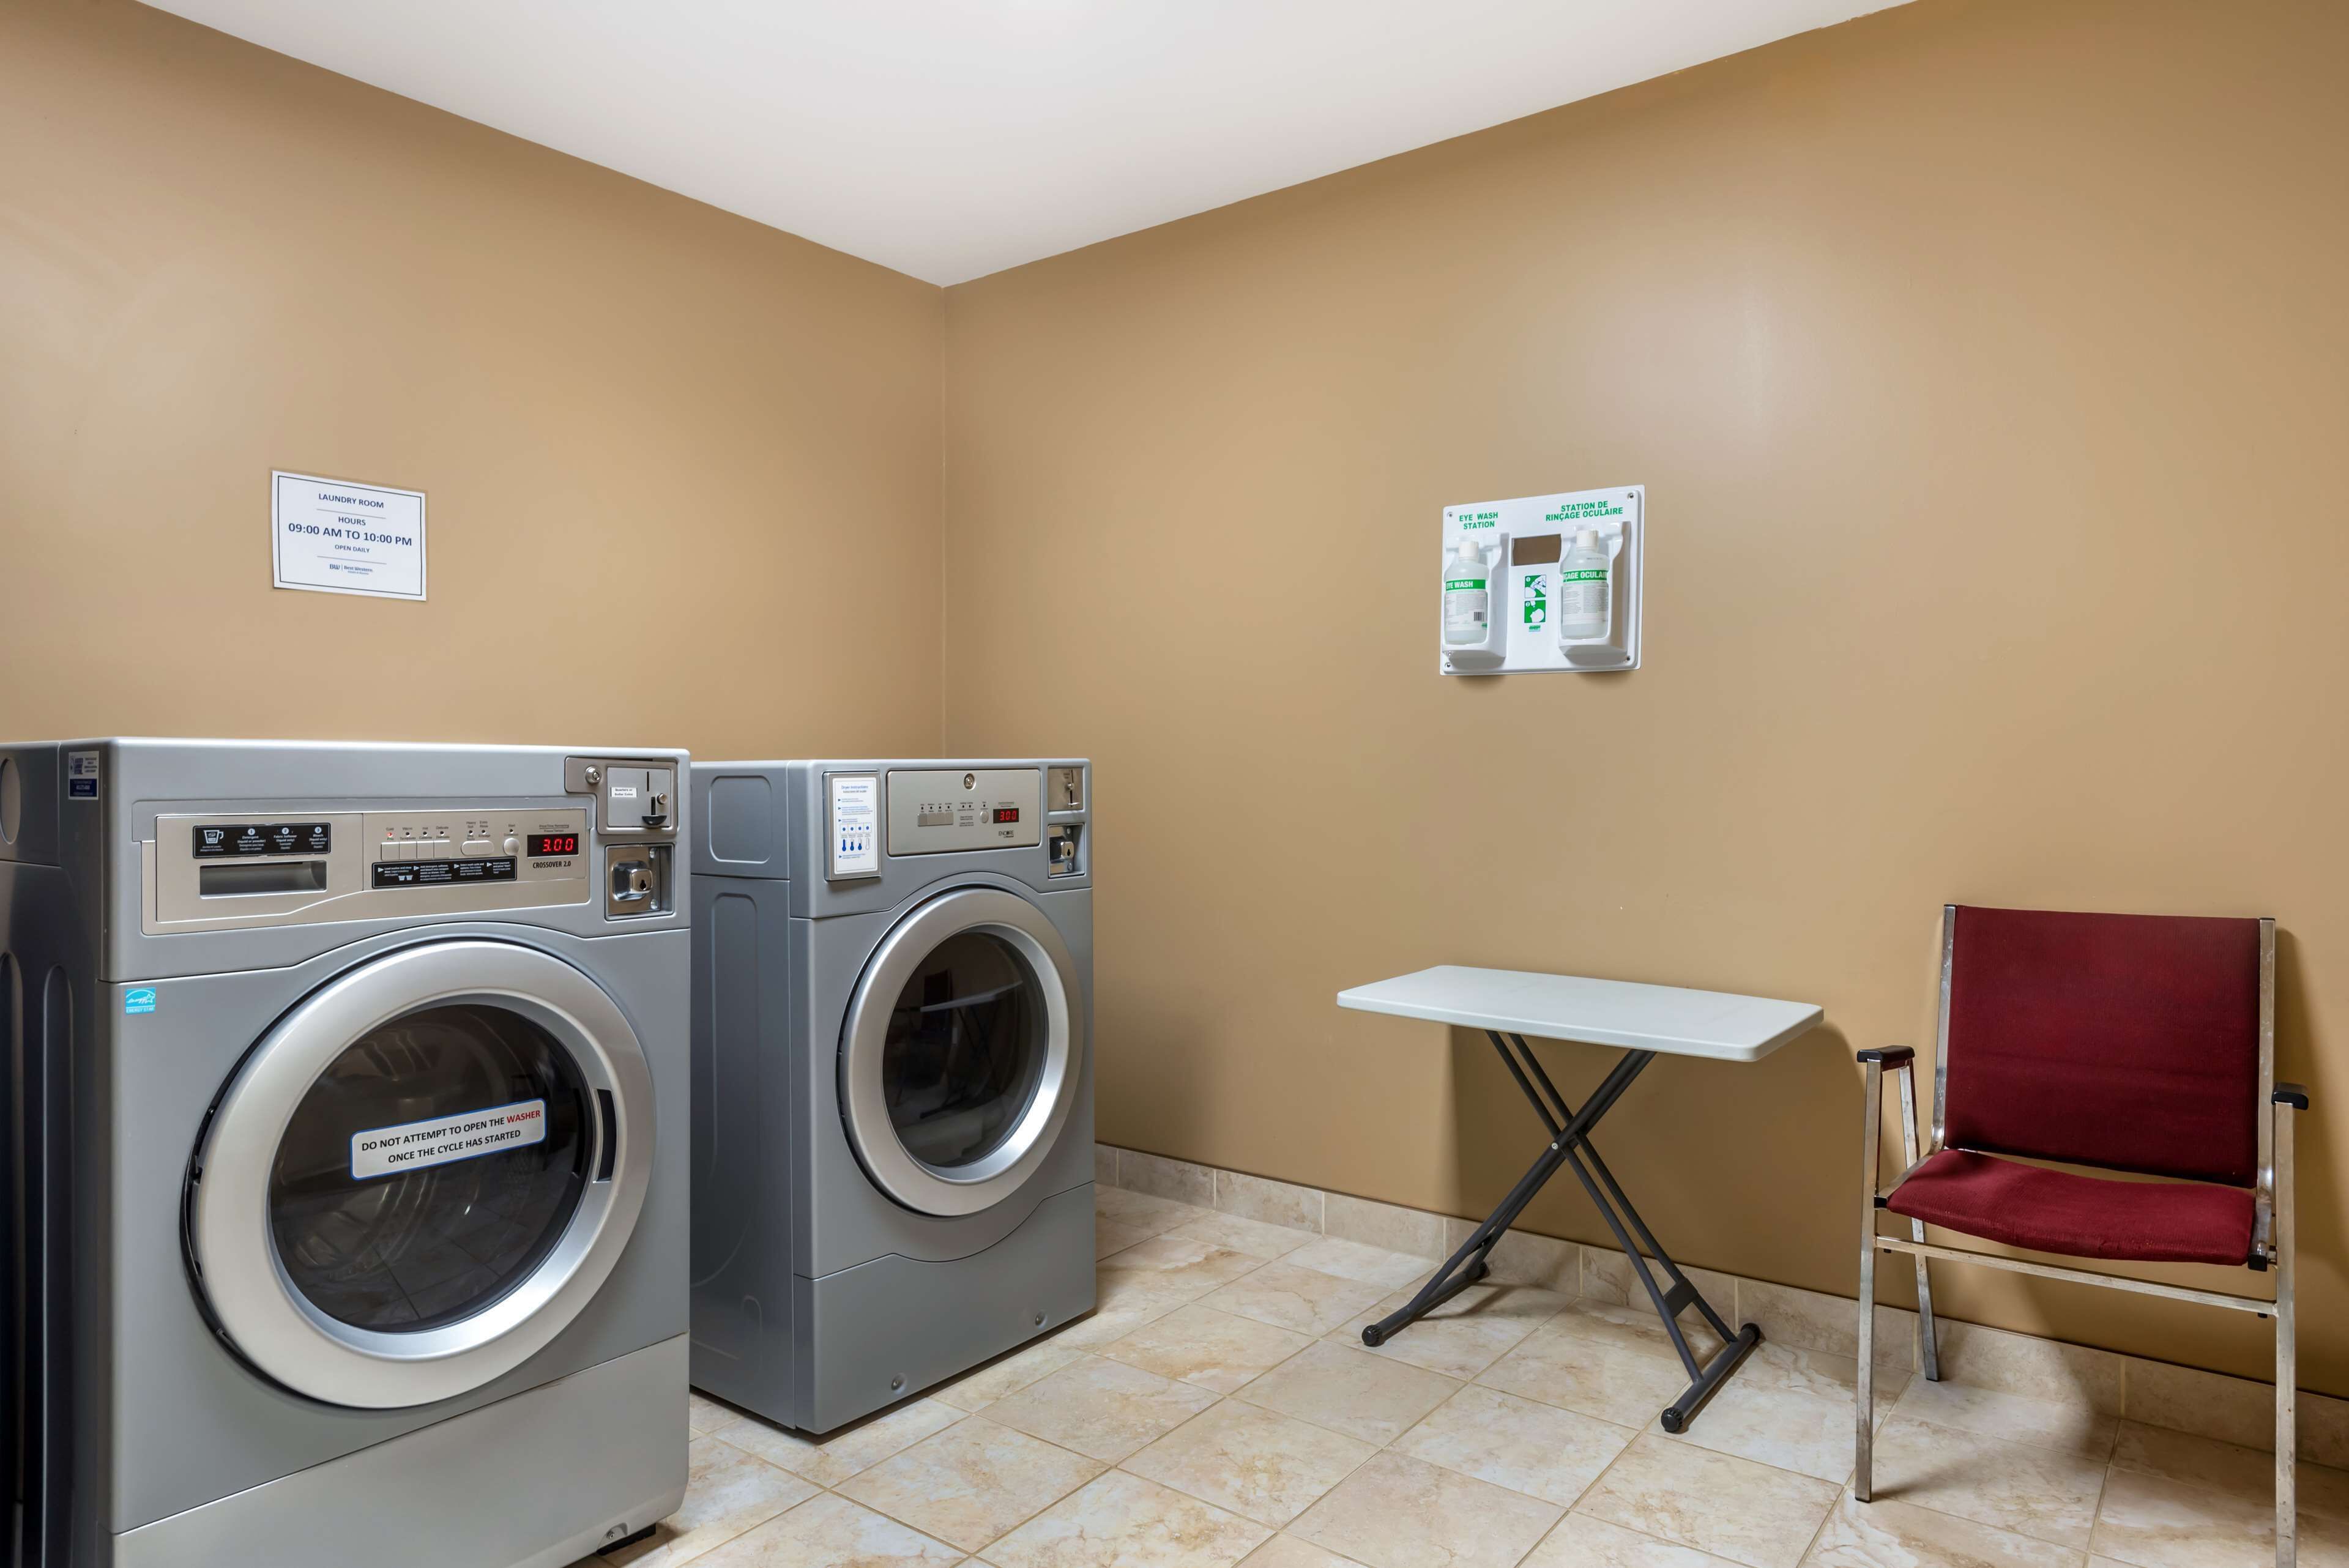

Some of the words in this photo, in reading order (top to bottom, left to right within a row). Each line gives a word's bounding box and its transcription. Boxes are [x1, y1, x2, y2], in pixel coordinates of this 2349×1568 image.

[318, 493, 356, 504] LAUNDRY
[359, 499, 384, 508] ROOM
[1561, 502, 1595, 512] STATION
[1597, 501, 1608, 509] DE
[338, 516, 366, 526] HOURS
[1477, 511, 1498, 520] WASH
[1546, 511, 1580, 522] RINÇAGE
[1582, 507, 1623, 517] OCULAIRE
[1463, 521, 1495, 530] STATION
[288, 523, 319, 535] 09:00
[323, 527, 342, 537] AM
[345, 529, 360, 540] TO
[363, 532, 392, 543] 10:00
[395, 536, 412, 546] PM
[543, 838, 573, 852] 3.00
[362, 1141, 377, 1151] DO
[380, 1137, 401, 1148] NOT
[403, 1129, 447, 1144] ATTEMPT
[449, 1126, 461, 1135] TO
[464, 1121, 487, 1132] OPEN
[490, 1117, 504, 1127] THE
[507, 1110, 541, 1123] WASHER
[388, 1151, 414, 1163] ONCE
[418, 1147, 435, 1158] THE
[438, 1142, 463, 1153] CYCLE
[466, 1138, 482, 1148] HAS
[485, 1130, 520, 1144] STARTED
